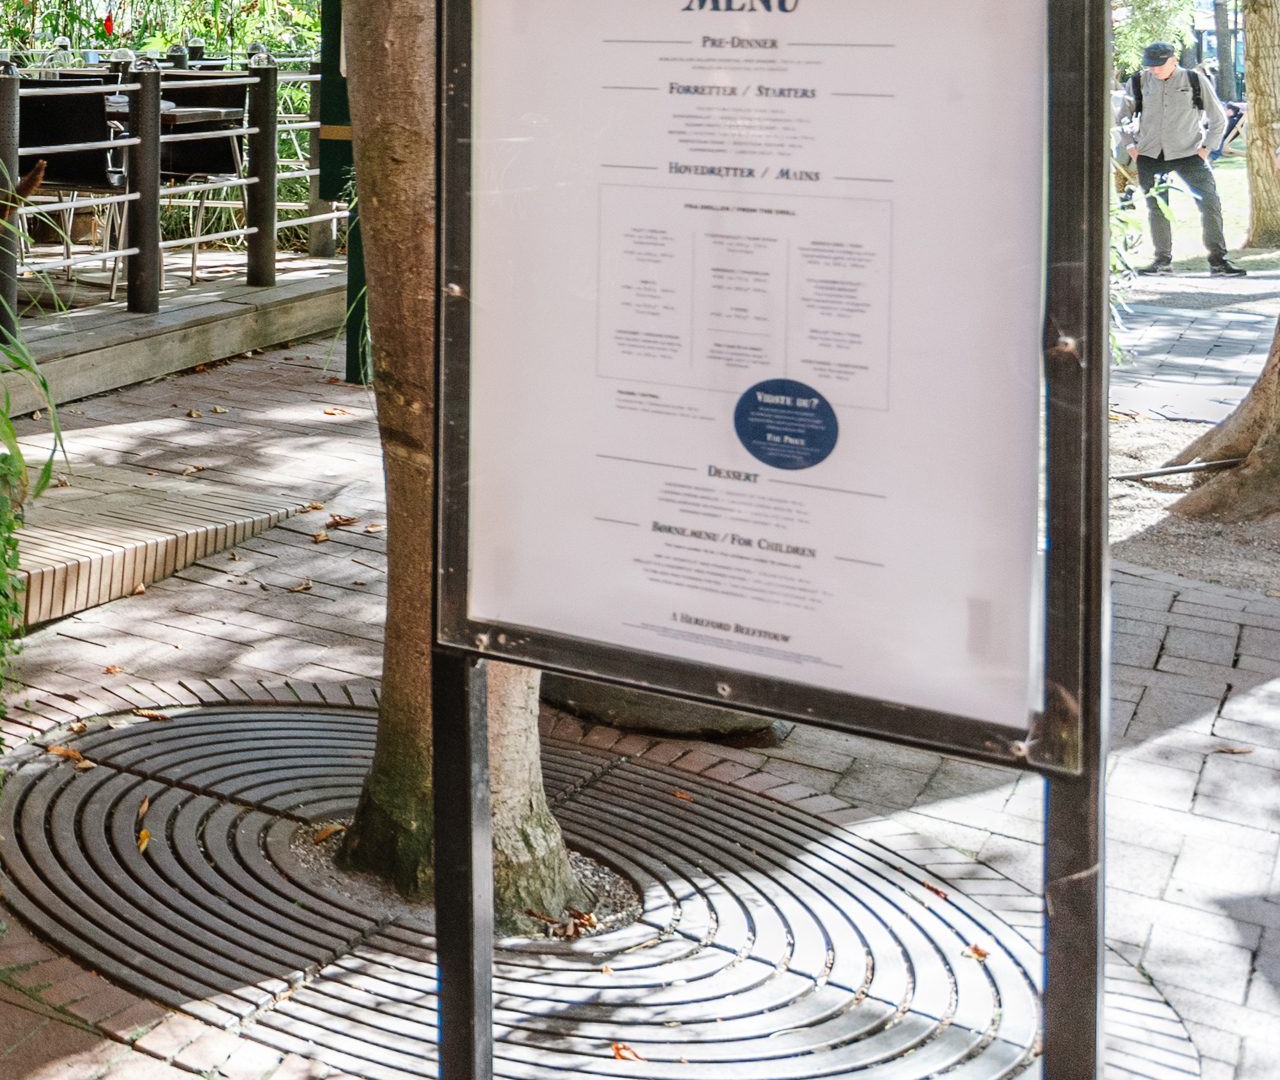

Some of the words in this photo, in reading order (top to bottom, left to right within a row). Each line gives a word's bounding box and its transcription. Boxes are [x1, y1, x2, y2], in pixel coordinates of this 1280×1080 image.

[701, 35, 779, 49] PRE-DINNER
[669, 82, 738, 96] FORRETTER
[755, 85, 817, 99] STARTERS
[775, 168, 821, 182] MAINS
[708, 465, 759, 483] DESSERT
[730, 534, 754, 548] FOR
[758, 538, 817, 559] CHILDREN
